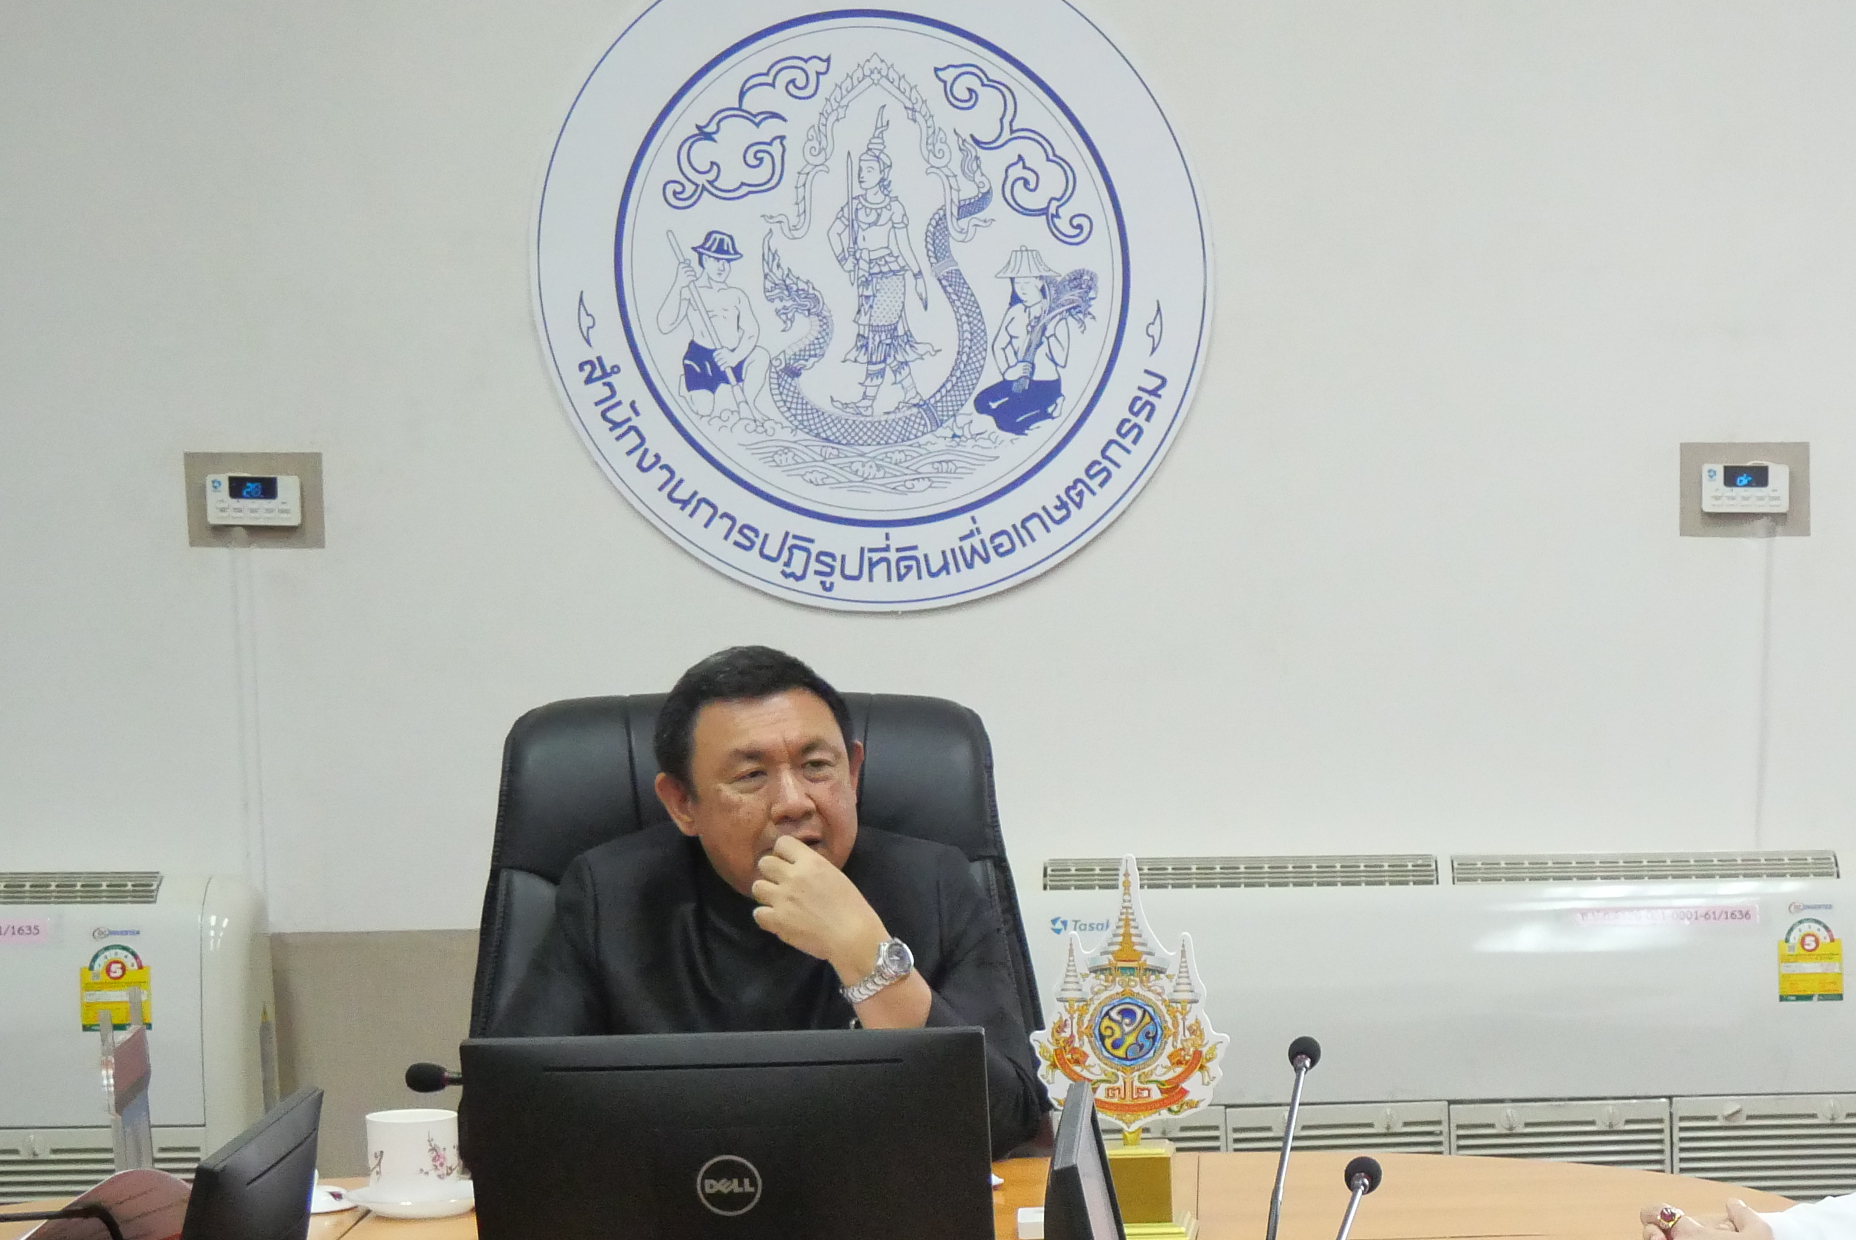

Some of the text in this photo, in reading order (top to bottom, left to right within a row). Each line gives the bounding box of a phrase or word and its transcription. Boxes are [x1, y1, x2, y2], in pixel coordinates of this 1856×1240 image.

[577, 358, 1167, 592] สำนักงานการปฏิรูปที่ดินเพื่อเกษตรกรรม
[1803, 935, 1817, 950] 5
[109, 963, 123, 977] 5
[704, 1178, 755, 1194] DELL
